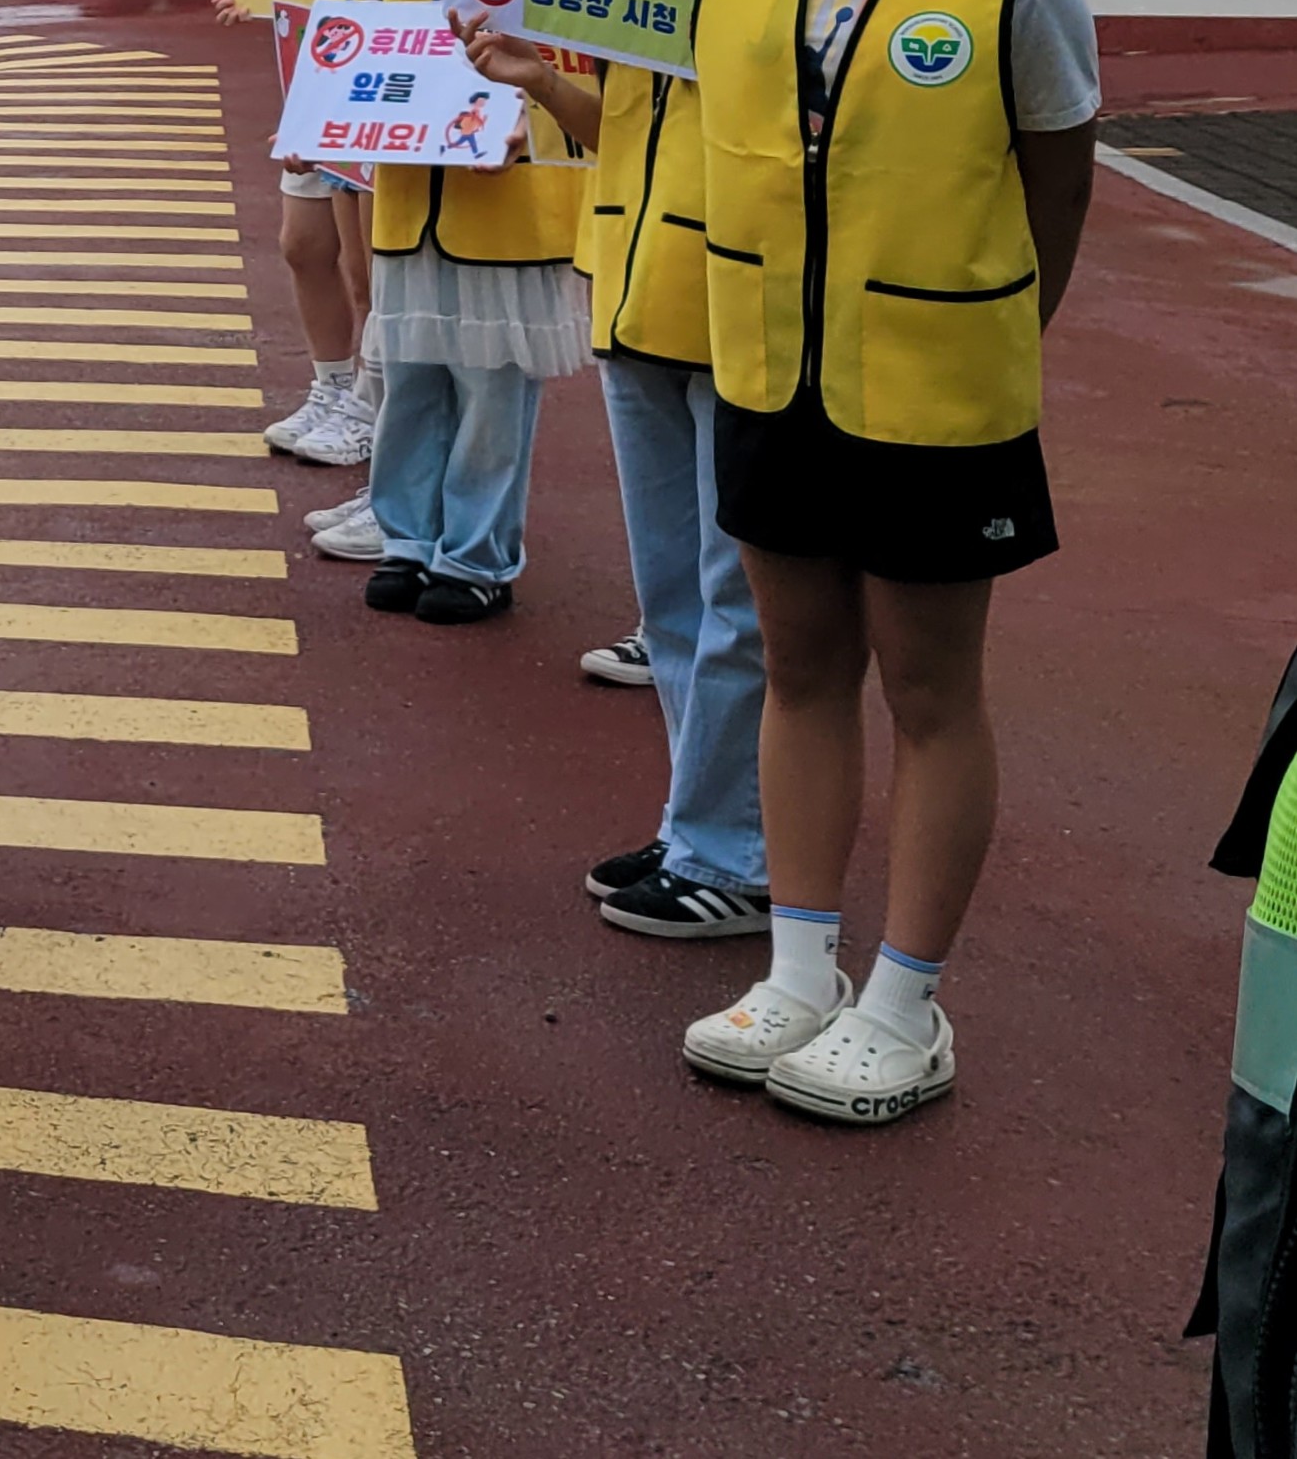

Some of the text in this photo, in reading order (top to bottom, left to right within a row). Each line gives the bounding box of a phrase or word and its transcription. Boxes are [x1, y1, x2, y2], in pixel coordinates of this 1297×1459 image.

[348, 73, 416, 103] 앞을
[318, 121, 429, 152] 보세요!
[852, 1084, 920, 1116] crocs
